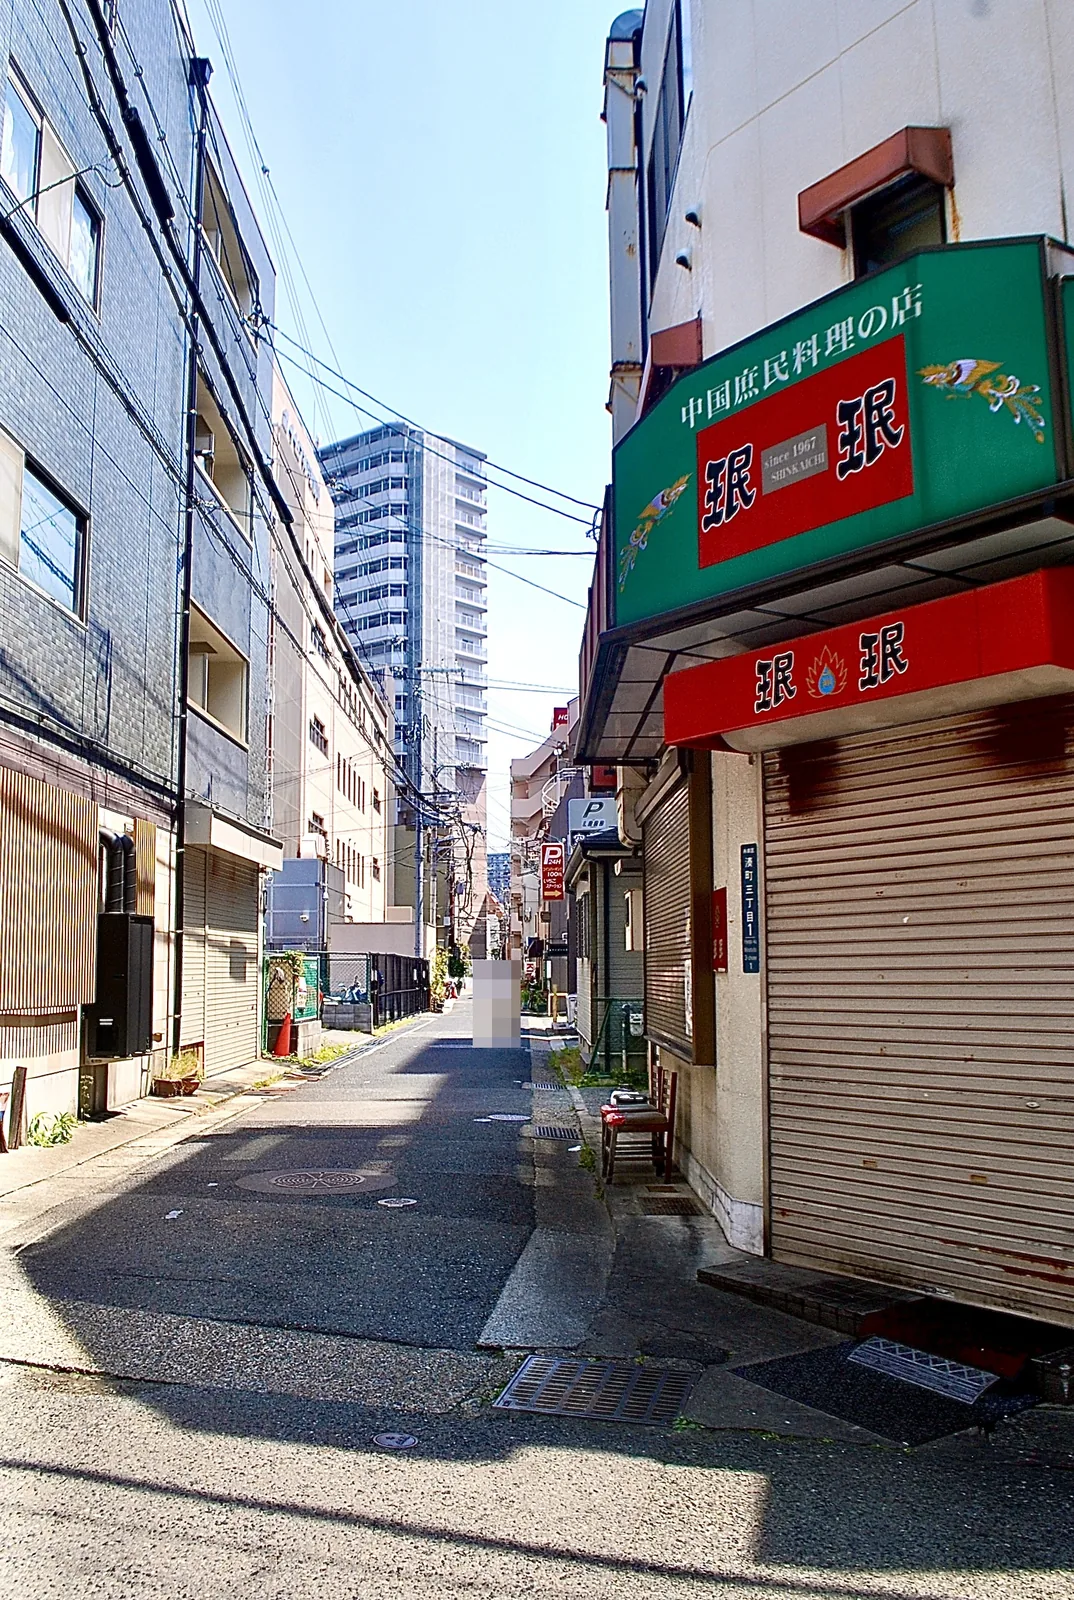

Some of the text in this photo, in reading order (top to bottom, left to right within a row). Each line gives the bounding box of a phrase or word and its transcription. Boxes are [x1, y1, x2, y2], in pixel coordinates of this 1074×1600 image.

[681, 283, 924, 428] 中国庶民料理の店
[764, 436, 817, 469] since 1967
[771, 452, 825, 482] SHINKAICHI
[582, 801, 605, 819] P
[544, 847, 562, 865] P
